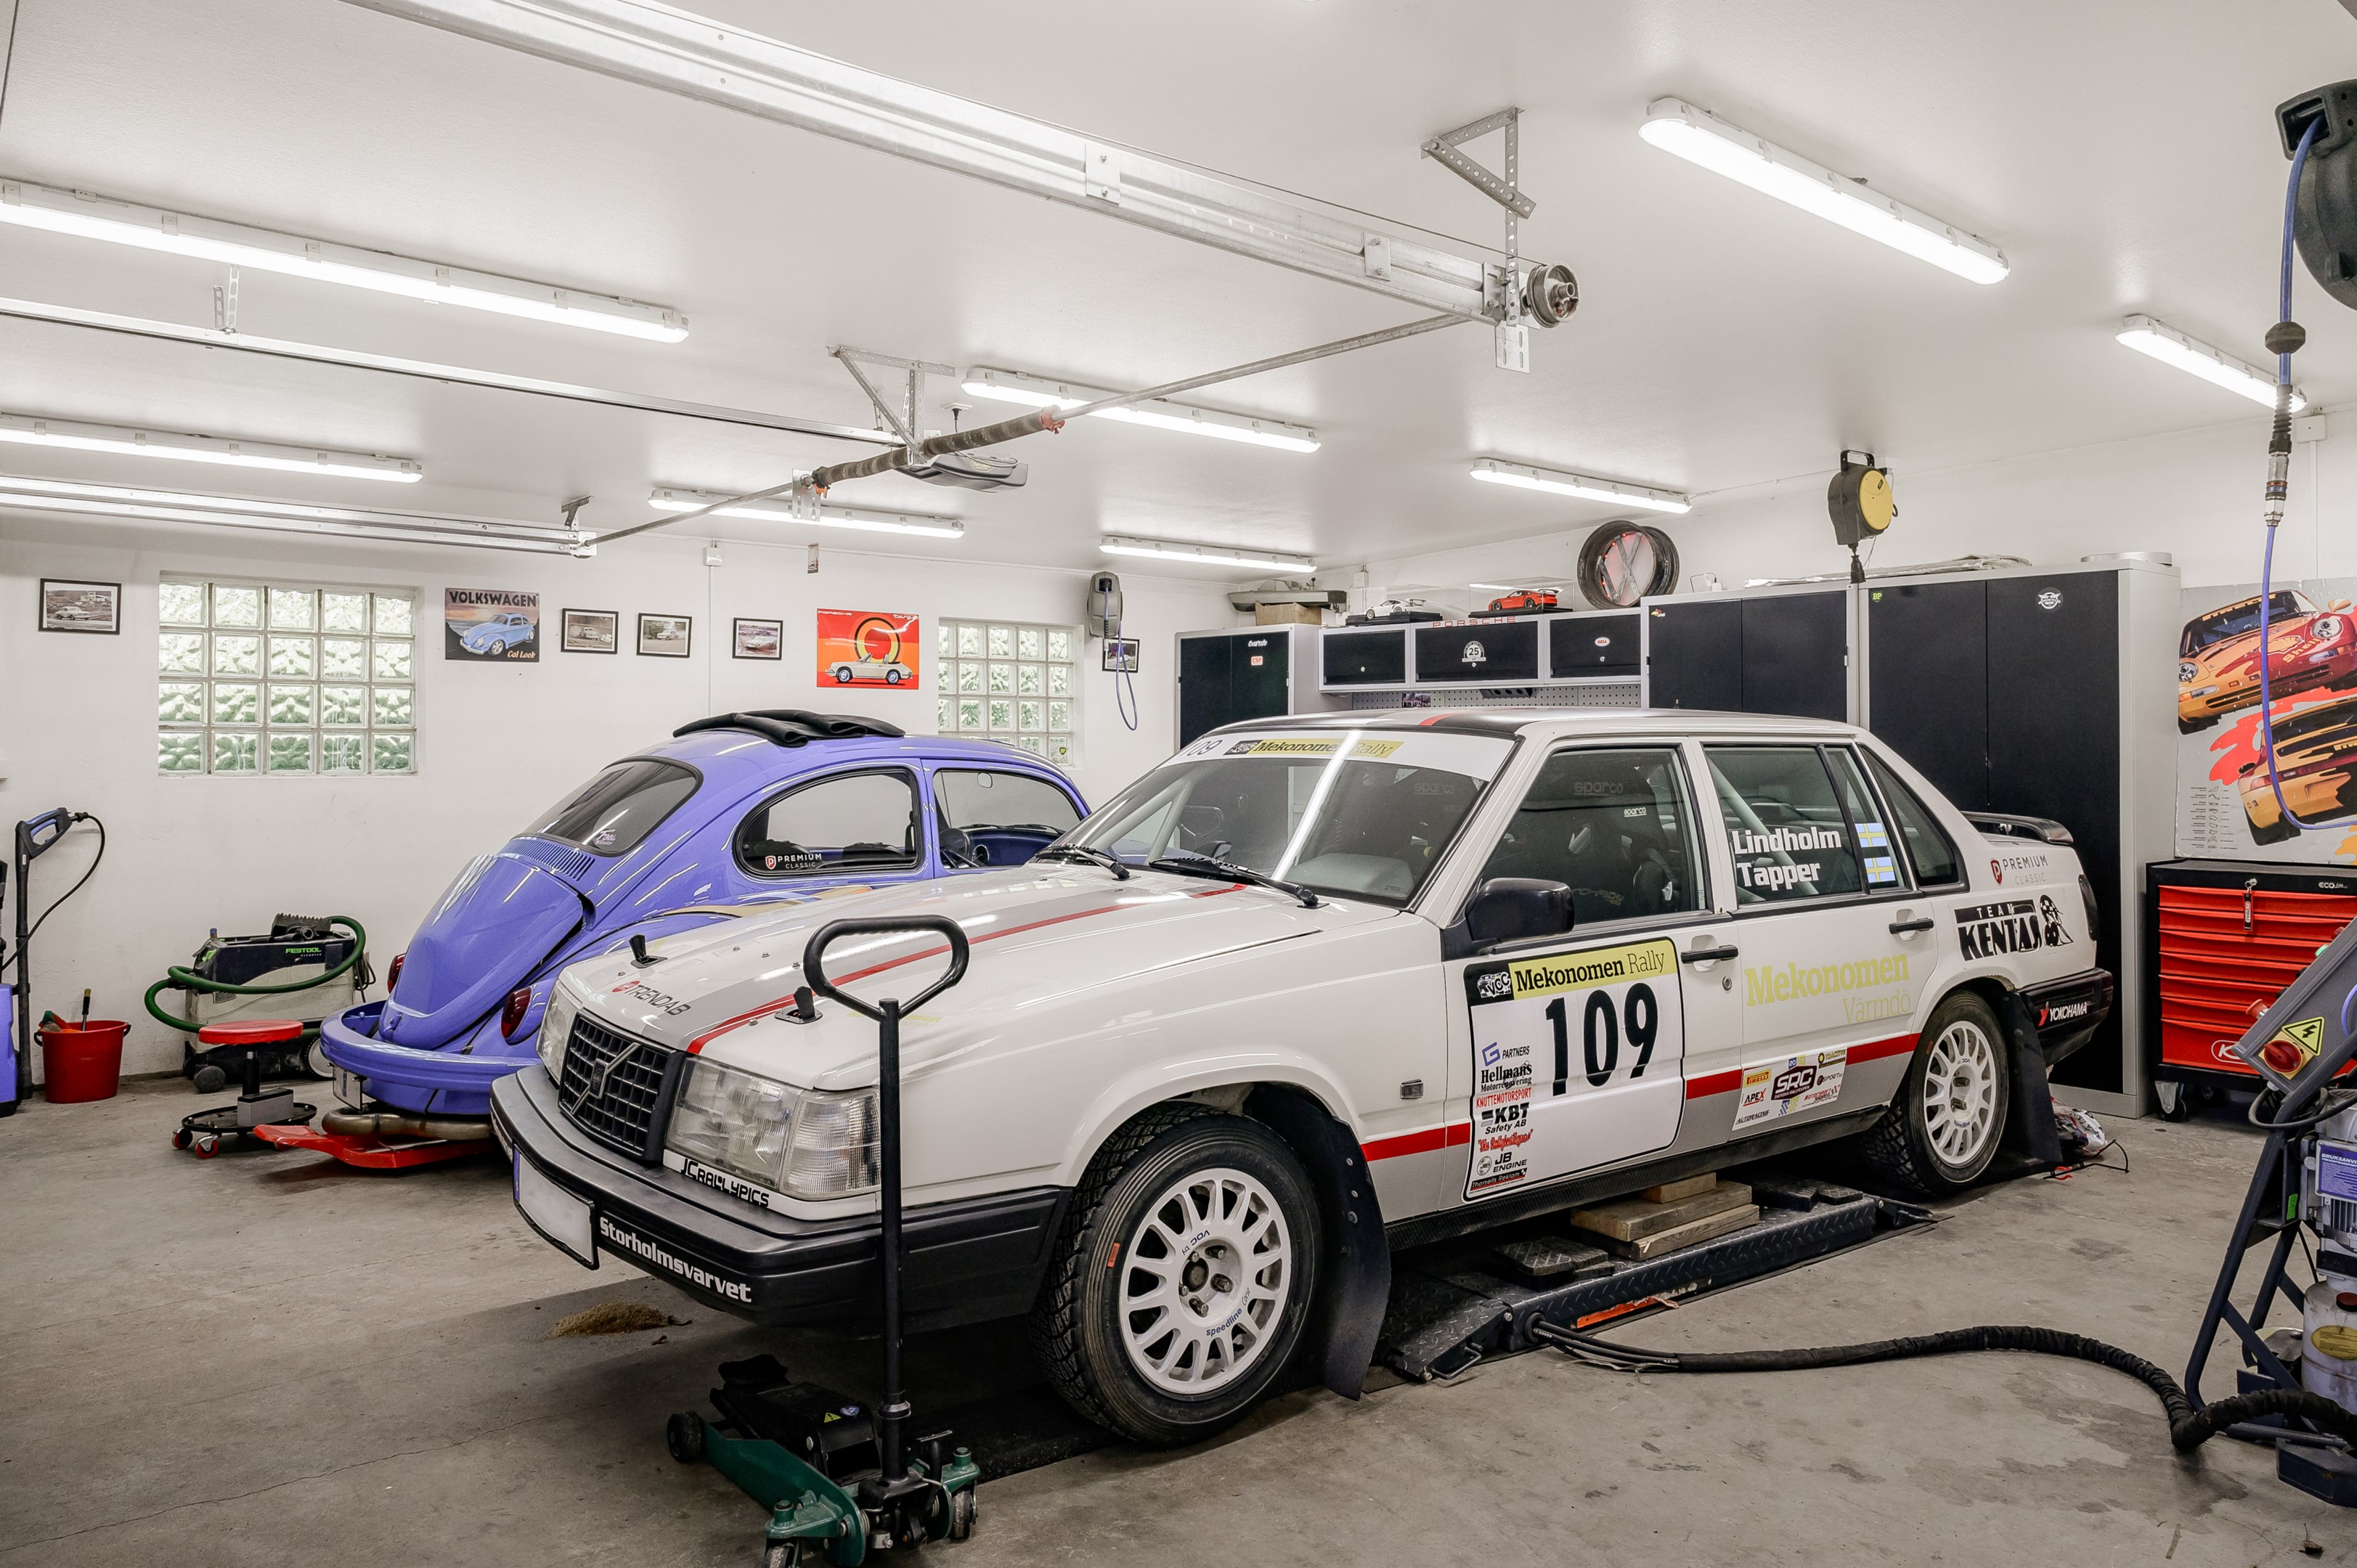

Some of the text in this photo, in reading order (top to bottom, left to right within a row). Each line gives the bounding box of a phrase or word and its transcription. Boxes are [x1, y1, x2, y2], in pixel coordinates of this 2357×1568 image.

[449, 591, 536, 608] VOLKSWAGEN
[1433, 616, 1515, 629] PORSCHE
[1469, 647, 1479, 656] 25
[2282, 638, 2321, 663] Shell
[1624, 807, 1647, 817] sparco
[1732, 827, 1841, 854] Lindholm
[778, 854, 822, 862] PREMIUM
[2002, 854, 2048, 870] PREMIUM
[1737, 863, 1820, 891] Tapper
[2015, 873, 2046, 885] CLASSIC
[1977, 903, 2014, 919] TEAM
[1958, 915, 2043, 961] KENTAS
[1515, 950, 1664, 992] Mekonomen Rally
[1744, 954, 1910, 1007] Mekonomen
[624, 984, 691, 1016] TRENDAB
[1842, 988, 1911, 1024] Värmdö
[2050, 1002, 2087, 1022] YOKOHAMA
[1545, 983, 1658, 1097] 109
[1502, 1045, 1530, 1059] PARTNERS
[1481, 1064, 1532, 1084] Hellmans
[1746, 1071, 1770, 1085] PIRELLI
[1775, 1068, 1814, 1094] SRC
[1476, 1087, 1531, 1108] KNUTTEMOTORSPORT
[1744, 1088, 1767, 1104] APEX
[1494, 1102, 1530, 1124] KBT
[1485, 1119, 1527, 1135] Safety AB
[1493, 1159, 1528, 1173] ENGINE
[1495, 1152, 1513, 1165] JB
[1472, 1177, 1497, 1188] Thorsells
[1498, 1172, 1521, 1181] Reklam
[600, 1216, 752, 1303] Storholmsvarvet
[1206, 1307, 1242, 1336] speedline
